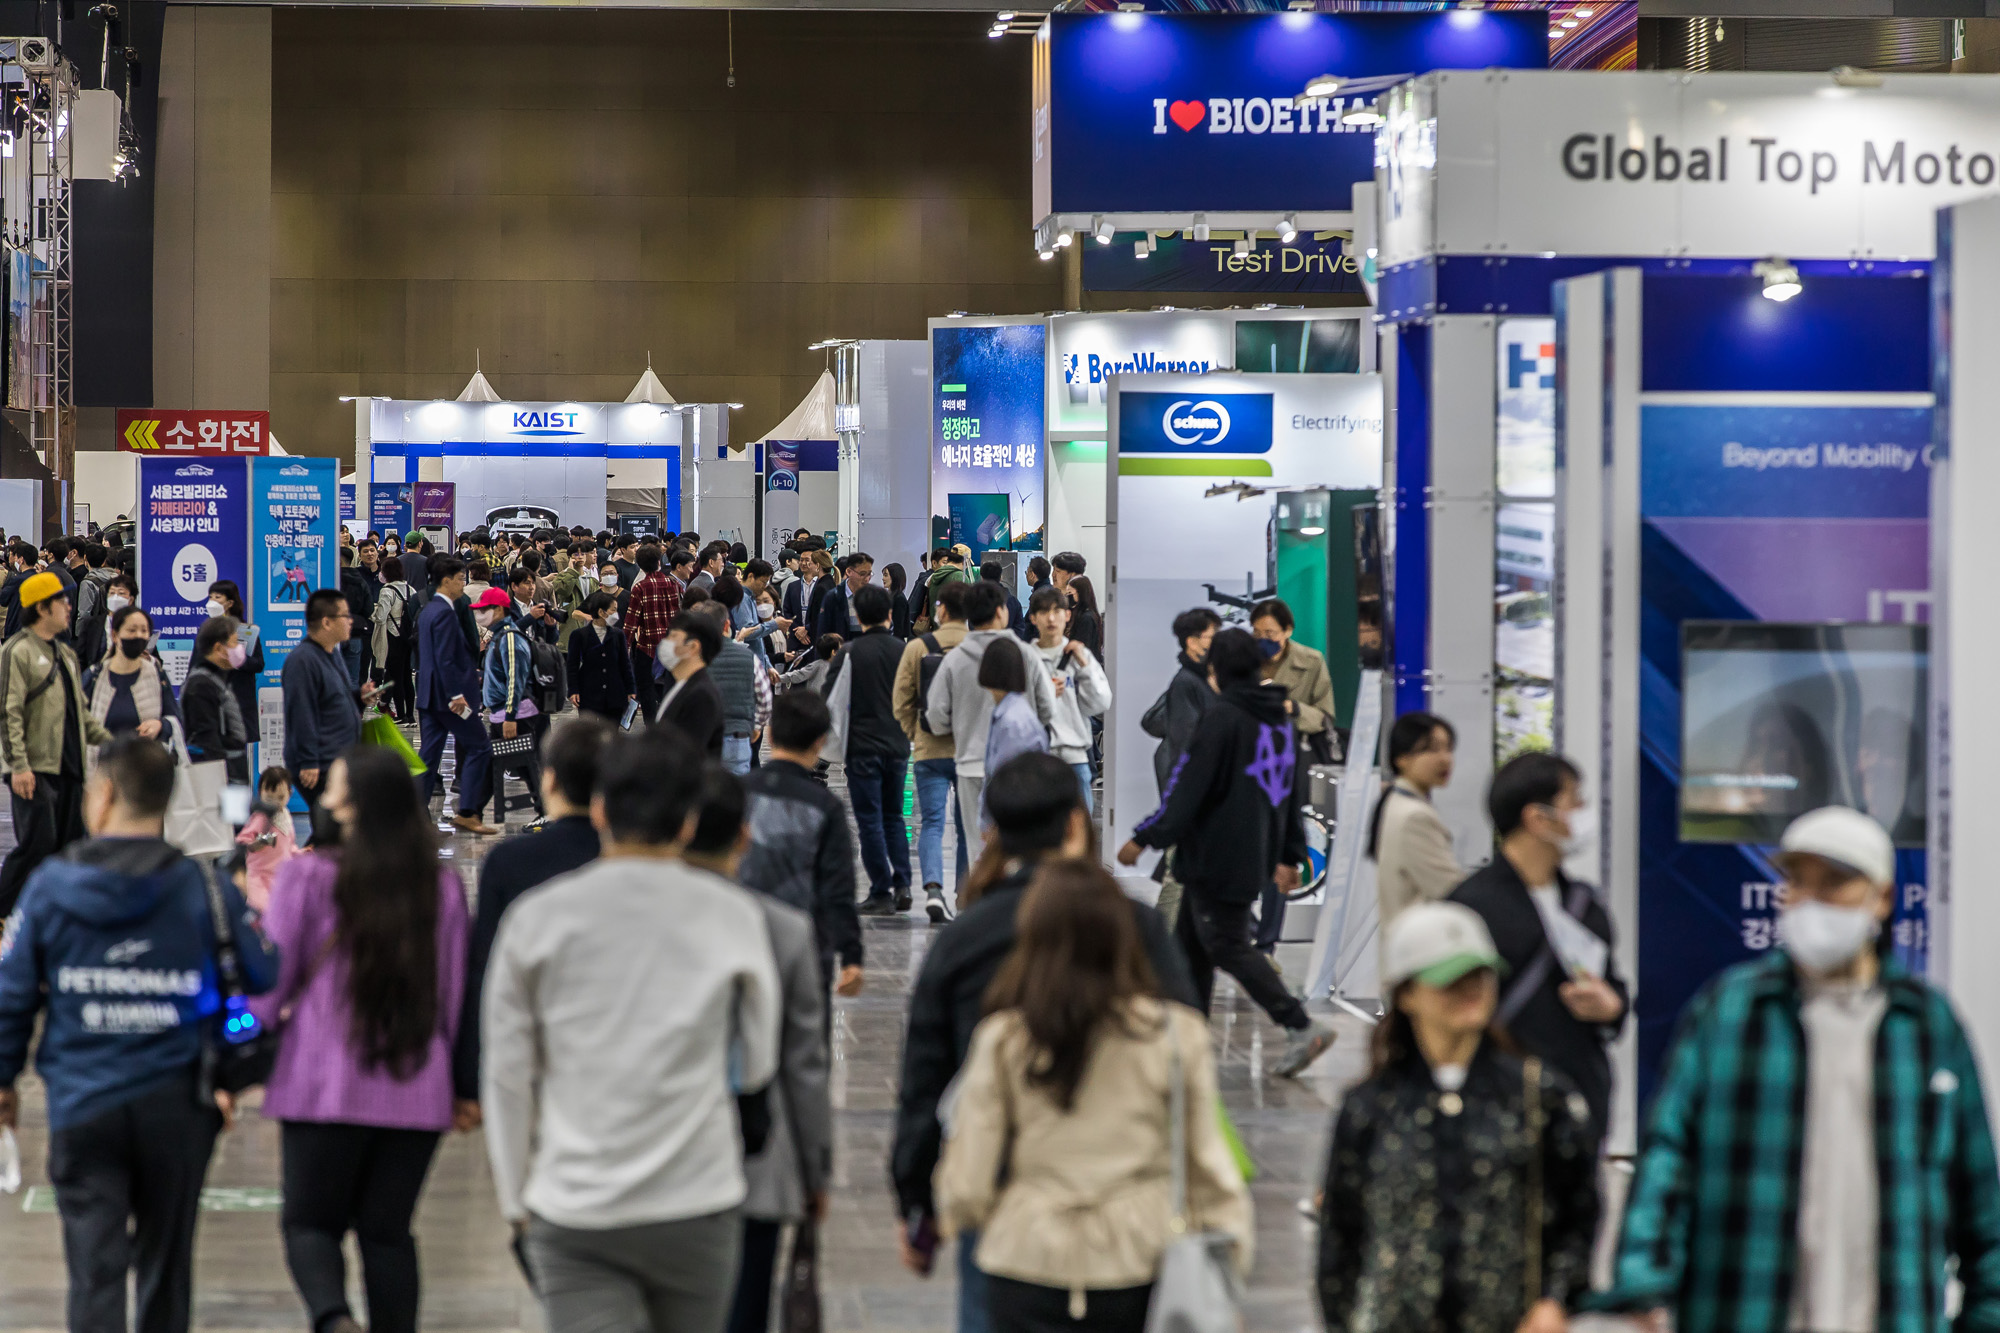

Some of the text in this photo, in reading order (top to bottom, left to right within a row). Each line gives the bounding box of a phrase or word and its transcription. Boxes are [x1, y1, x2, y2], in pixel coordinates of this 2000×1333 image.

[1153, 97, 1377, 135] I BIOETHA
[1562, 132, 2000, 194] Global Top Moto
[1210, 247, 1358, 273] Test Drive
[513, 411, 578, 428] KAIST
[941, 416, 981, 441] 청정하고
[1292, 414, 1382, 434] Electrifying
[165, 419, 260, 452] 소화전
[941, 444, 1036, 468] 에너지 효율적인 세상
[1722, 442, 1818, 471] Beyond
[1822, 442, 1918, 472] Mobility
[150, 484, 228, 500] 서울모빌리티쇼
[150, 500, 218, 516] 카페테리아 &
[284, 504, 320, 519] 포토존에서
[150, 517, 220, 533] 시승행사 안내
[278, 520, 309, 533] 사진 찍고
[264, 534, 324, 548] 인증하고 선물받자!
[182, 563, 208, 582] 5홀
[150, 606, 163, 615] 시승
[164, 606, 177, 616] 운영
[178, 606, 191, 616] 시간
[162, 626, 173, 635] 시승
[57, 965, 203, 997] PETRONAS
